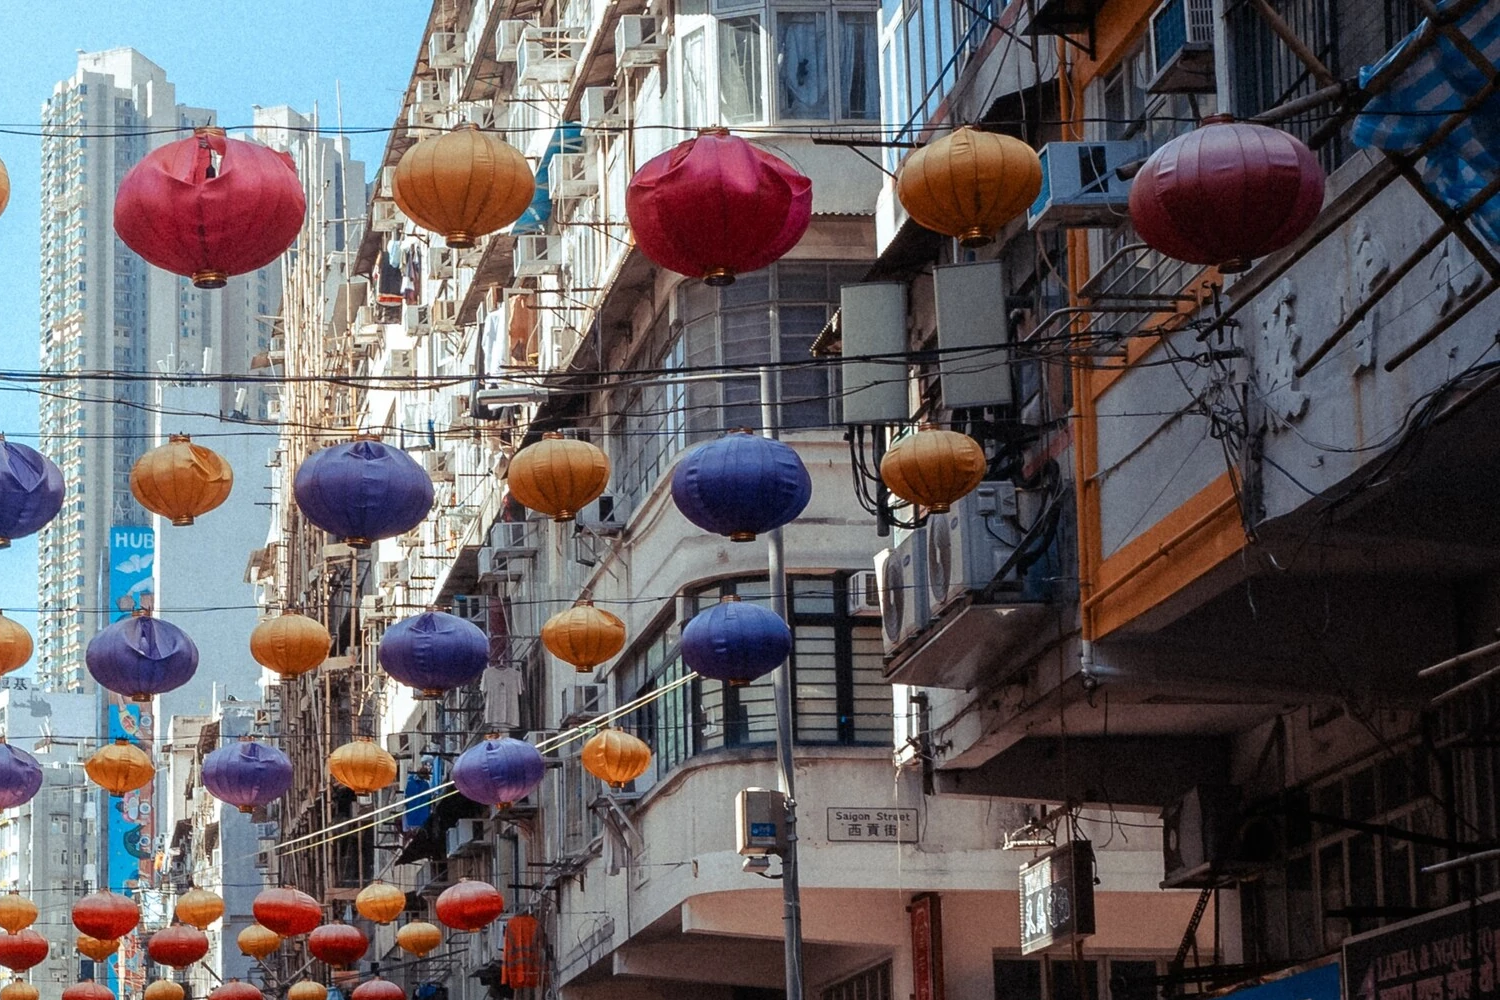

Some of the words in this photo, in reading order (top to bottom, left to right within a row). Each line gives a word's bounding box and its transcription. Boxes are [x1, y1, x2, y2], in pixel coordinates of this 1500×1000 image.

[115, 532, 154, 549] HUB
[835, 811, 870, 822] Saigon
[876, 811, 911, 821] Street
[848, 823, 898, 837] 西貢街
